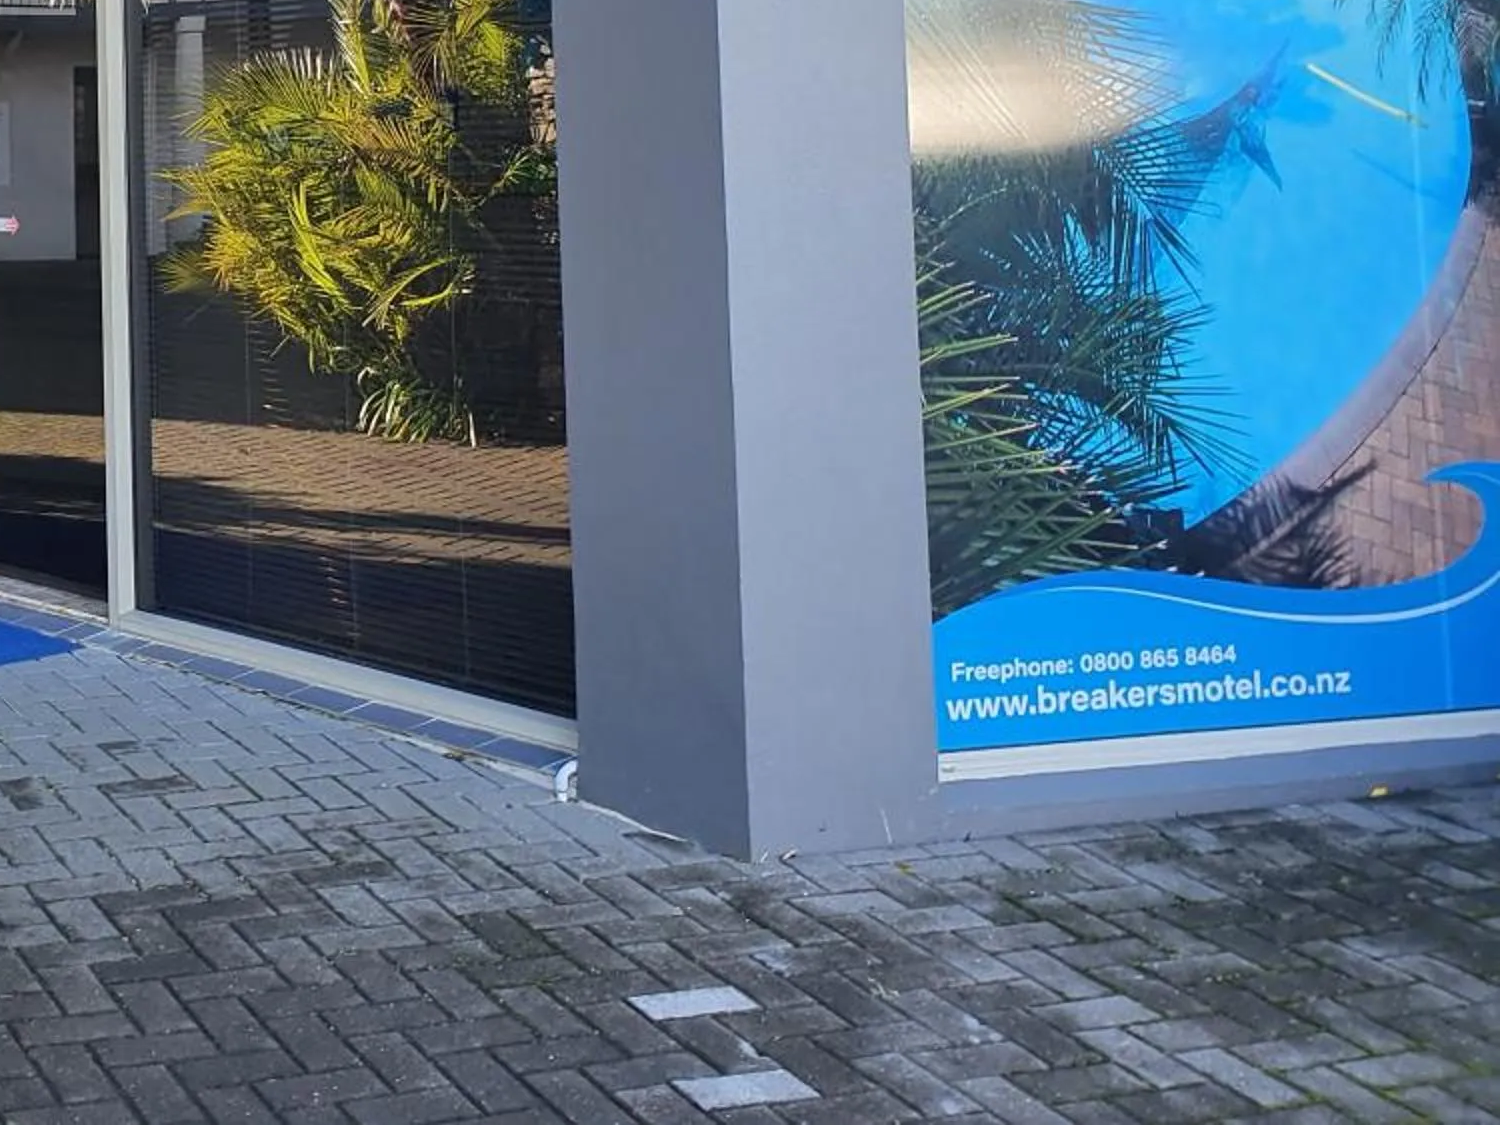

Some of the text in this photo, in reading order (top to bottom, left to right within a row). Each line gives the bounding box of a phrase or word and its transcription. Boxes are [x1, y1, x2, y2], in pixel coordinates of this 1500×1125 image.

[952, 644, 1236, 684] Freephone: 0800 865 8464
[946, 669, 1350, 721] www.breakersmotel.co.nz
